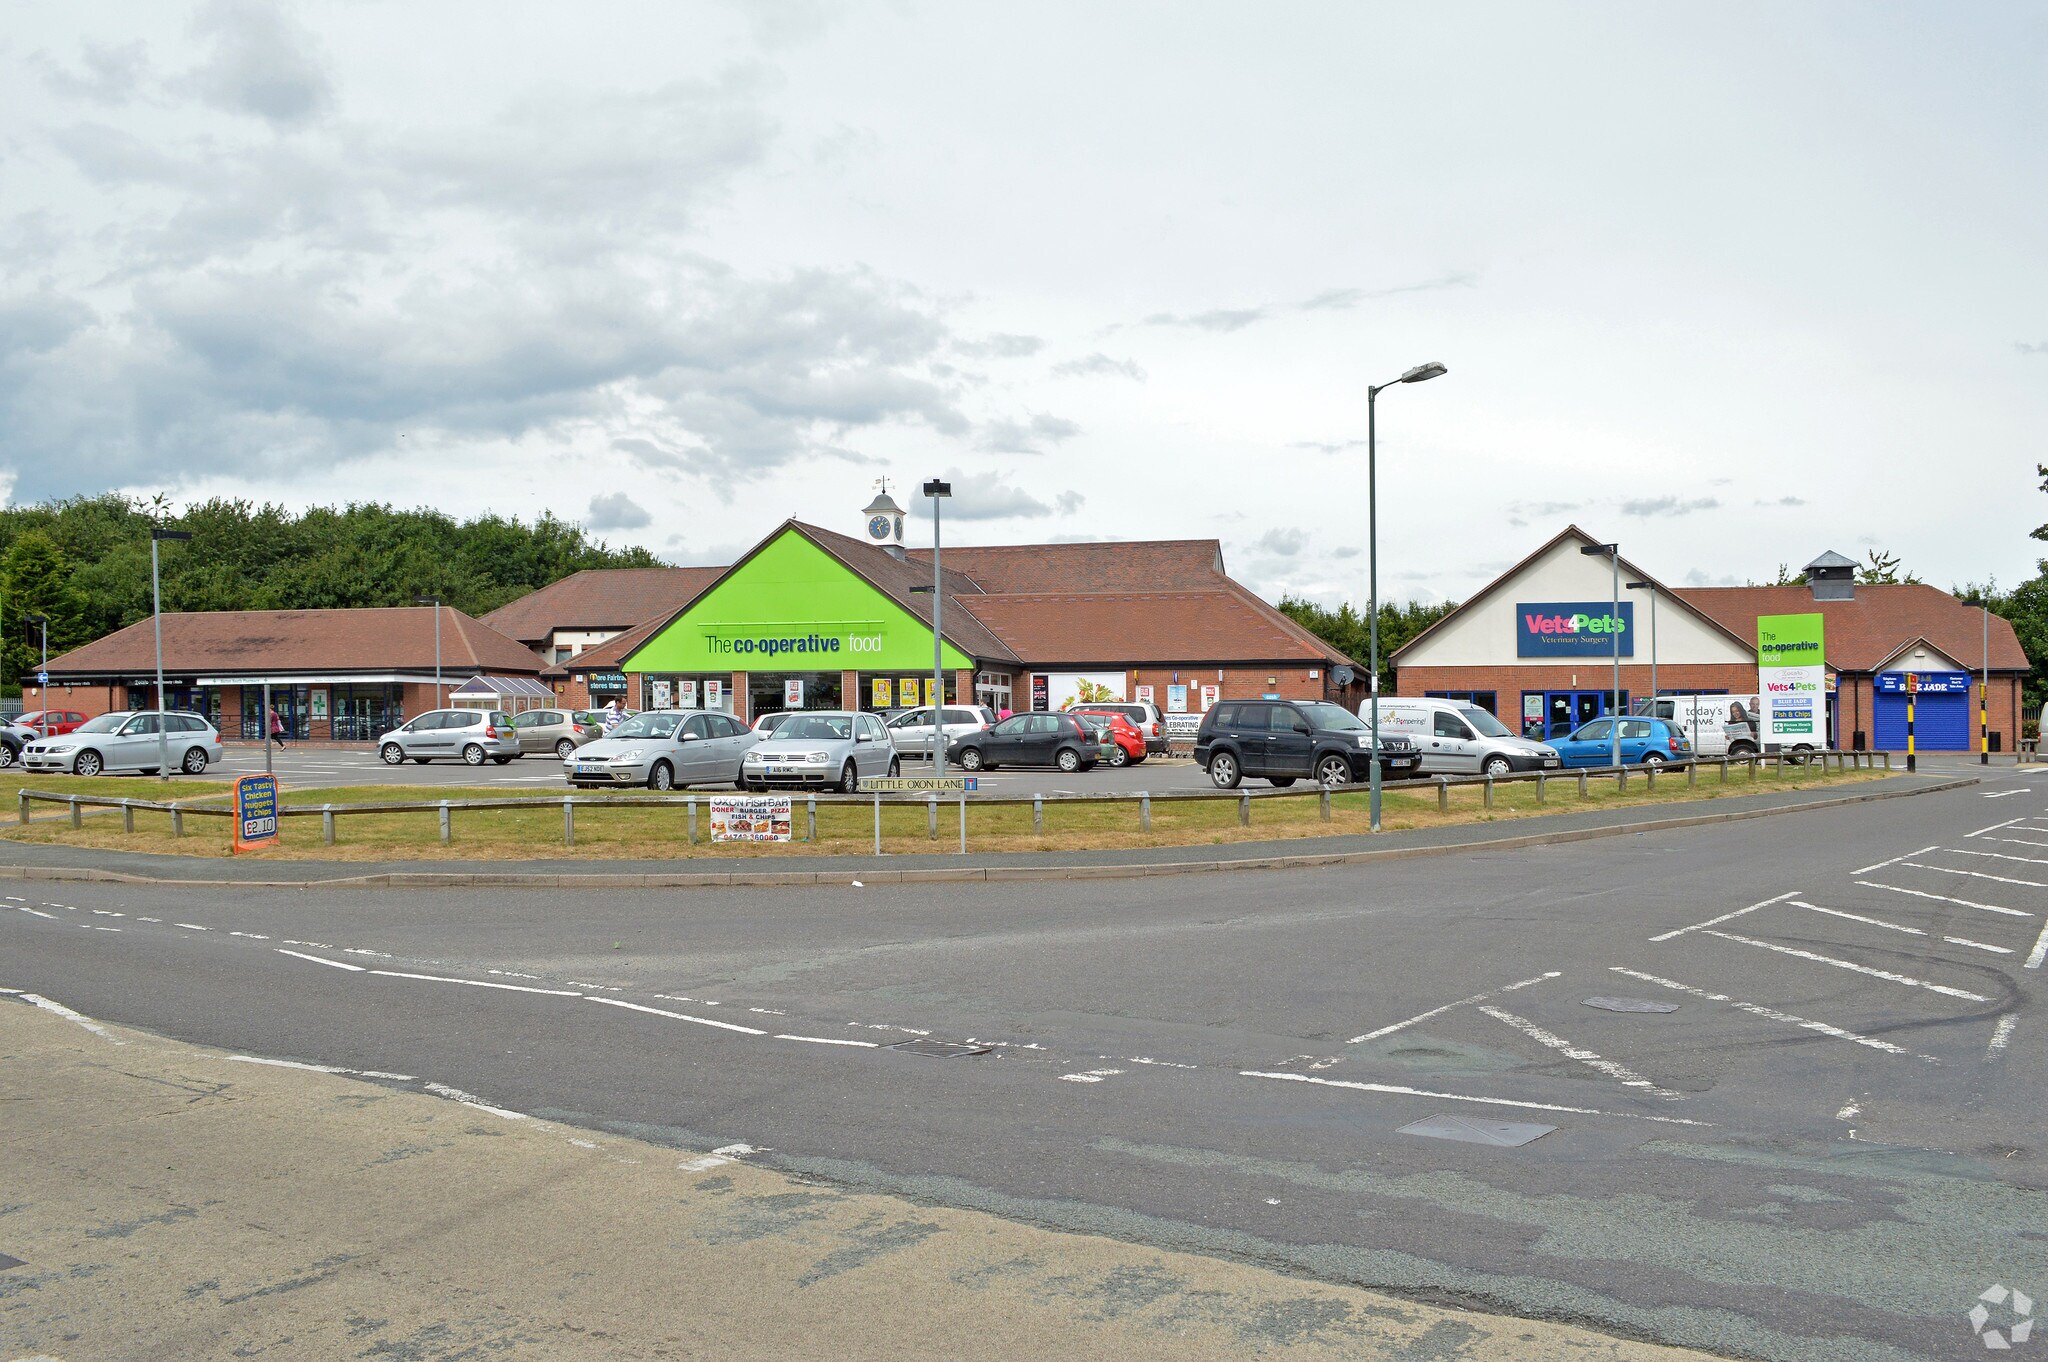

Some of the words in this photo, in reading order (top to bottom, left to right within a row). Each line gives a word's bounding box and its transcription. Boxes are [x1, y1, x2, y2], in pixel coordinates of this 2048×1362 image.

[1525, 614, 1625, 634] Vets4Pets
[1541, 636, 1579, 645] Veterinary
[1580, 635, 1609, 645] Surgery
[1762, 632, 1776, 641] The
[705, 636, 731, 653] The
[734, 635, 840, 657] co-operative
[848, 633, 882, 652] food
[1762, 641, 1818, 652] co-operative
[1762, 653, 1780, 662] food
[590, 673, 606, 681] More
[607, 673, 625, 681] Fairtra
[1767, 682, 1817, 691] Vets4Pets
[1685, 706, 1723, 717] today's
[1686, 718, 1714, 726] news
[254, 782, 273, 790] Tasty
[870, 780, 903, 789] LITTLE
[907, 780, 934, 788] OXON
[937, 780, 964, 789] LANE
[245, 791, 272, 800] Chicken
[244, 800, 273, 809] Nuggets
[713, 798, 743, 806] OXON
[746, 798, 766, 807] FISH
[768, 799, 788, 807] BAR
[254, 809, 272, 817] Chips
[247, 819, 273, 834] £2.10
